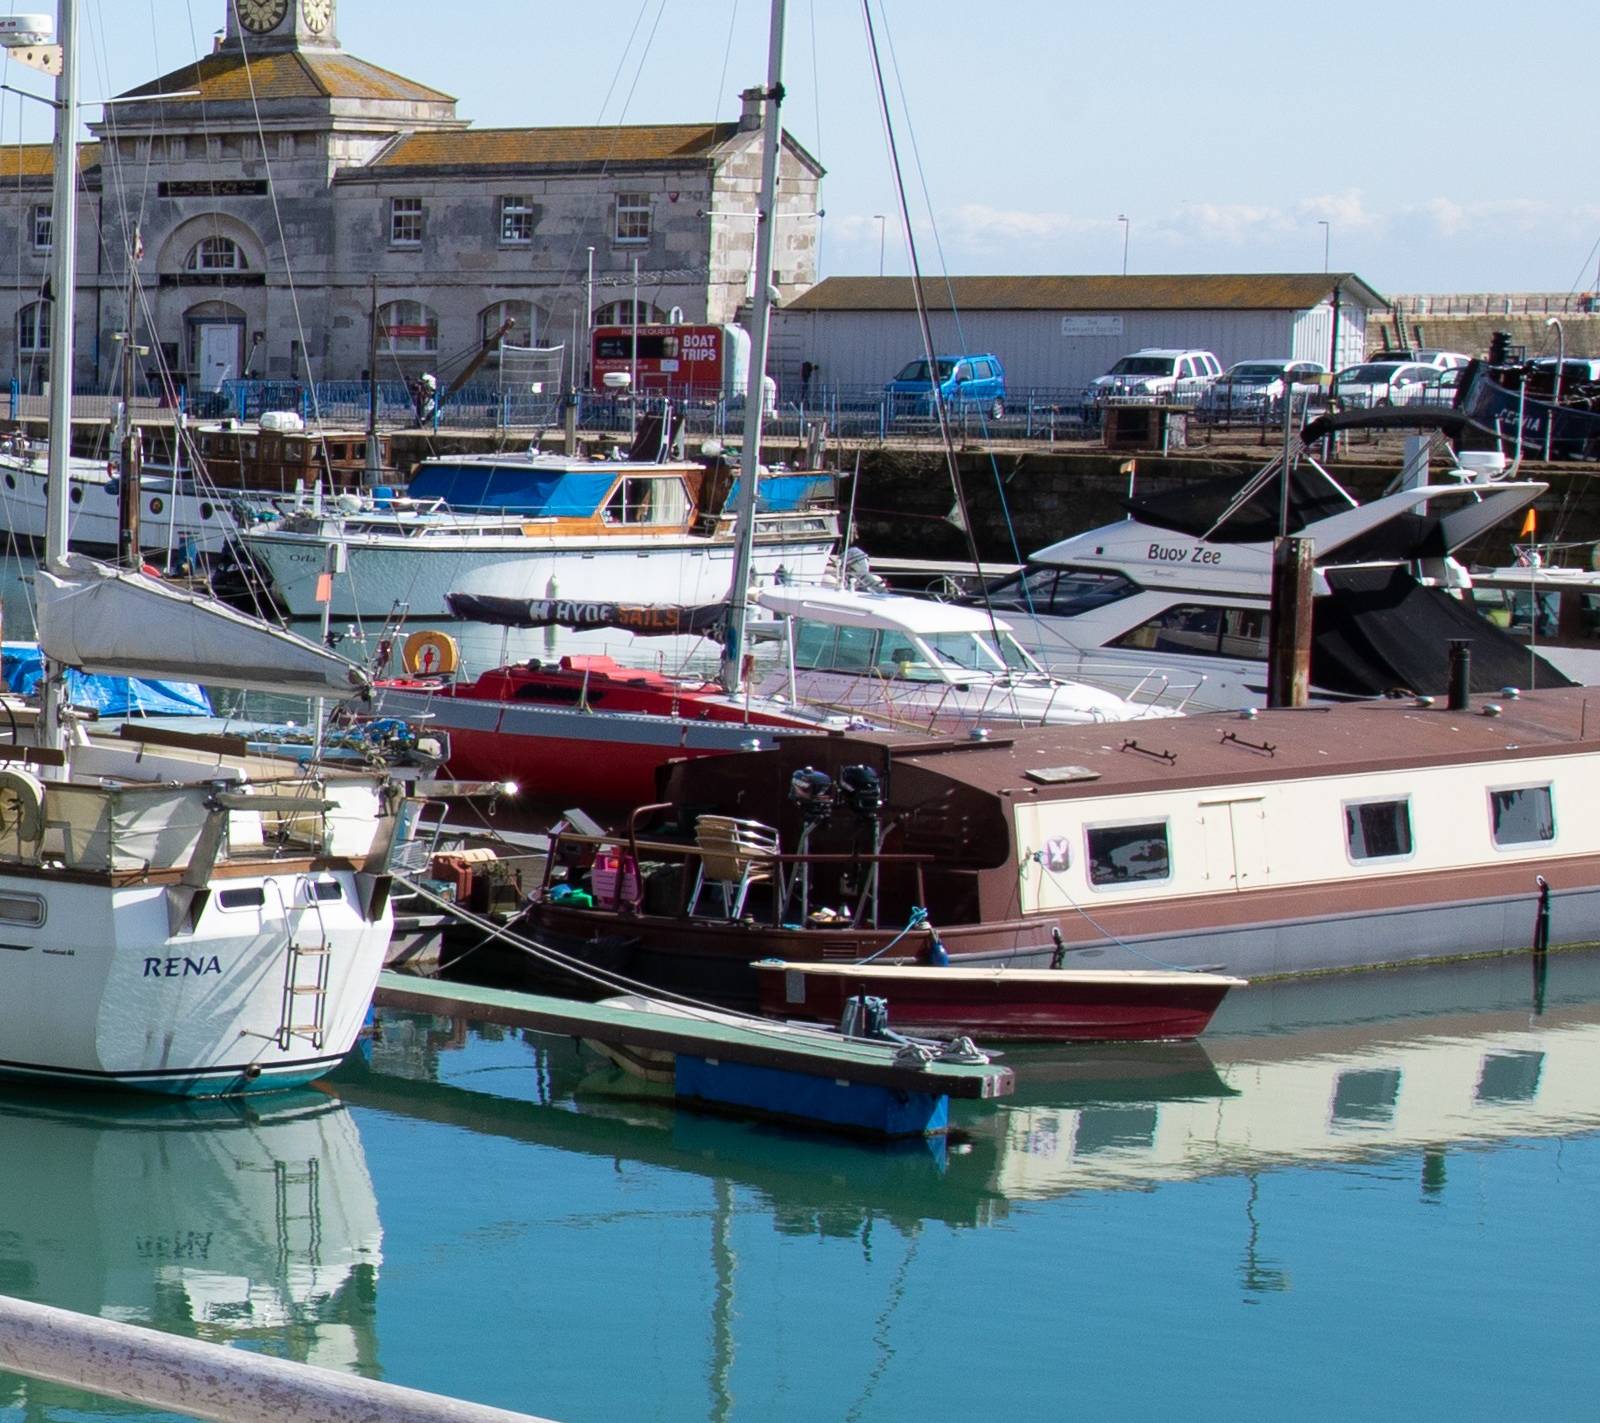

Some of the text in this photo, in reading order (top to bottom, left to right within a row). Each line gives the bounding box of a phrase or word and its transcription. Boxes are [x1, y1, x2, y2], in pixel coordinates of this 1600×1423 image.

[683, 335, 715, 347] BOAT
[682, 348, 716, 360] TRIPS
[1191, 547, 1221, 564] Zee
[556, 600, 613, 622] HYDE
[618, 606, 679, 626] SAILS
[143, 955, 222, 977] RENA
